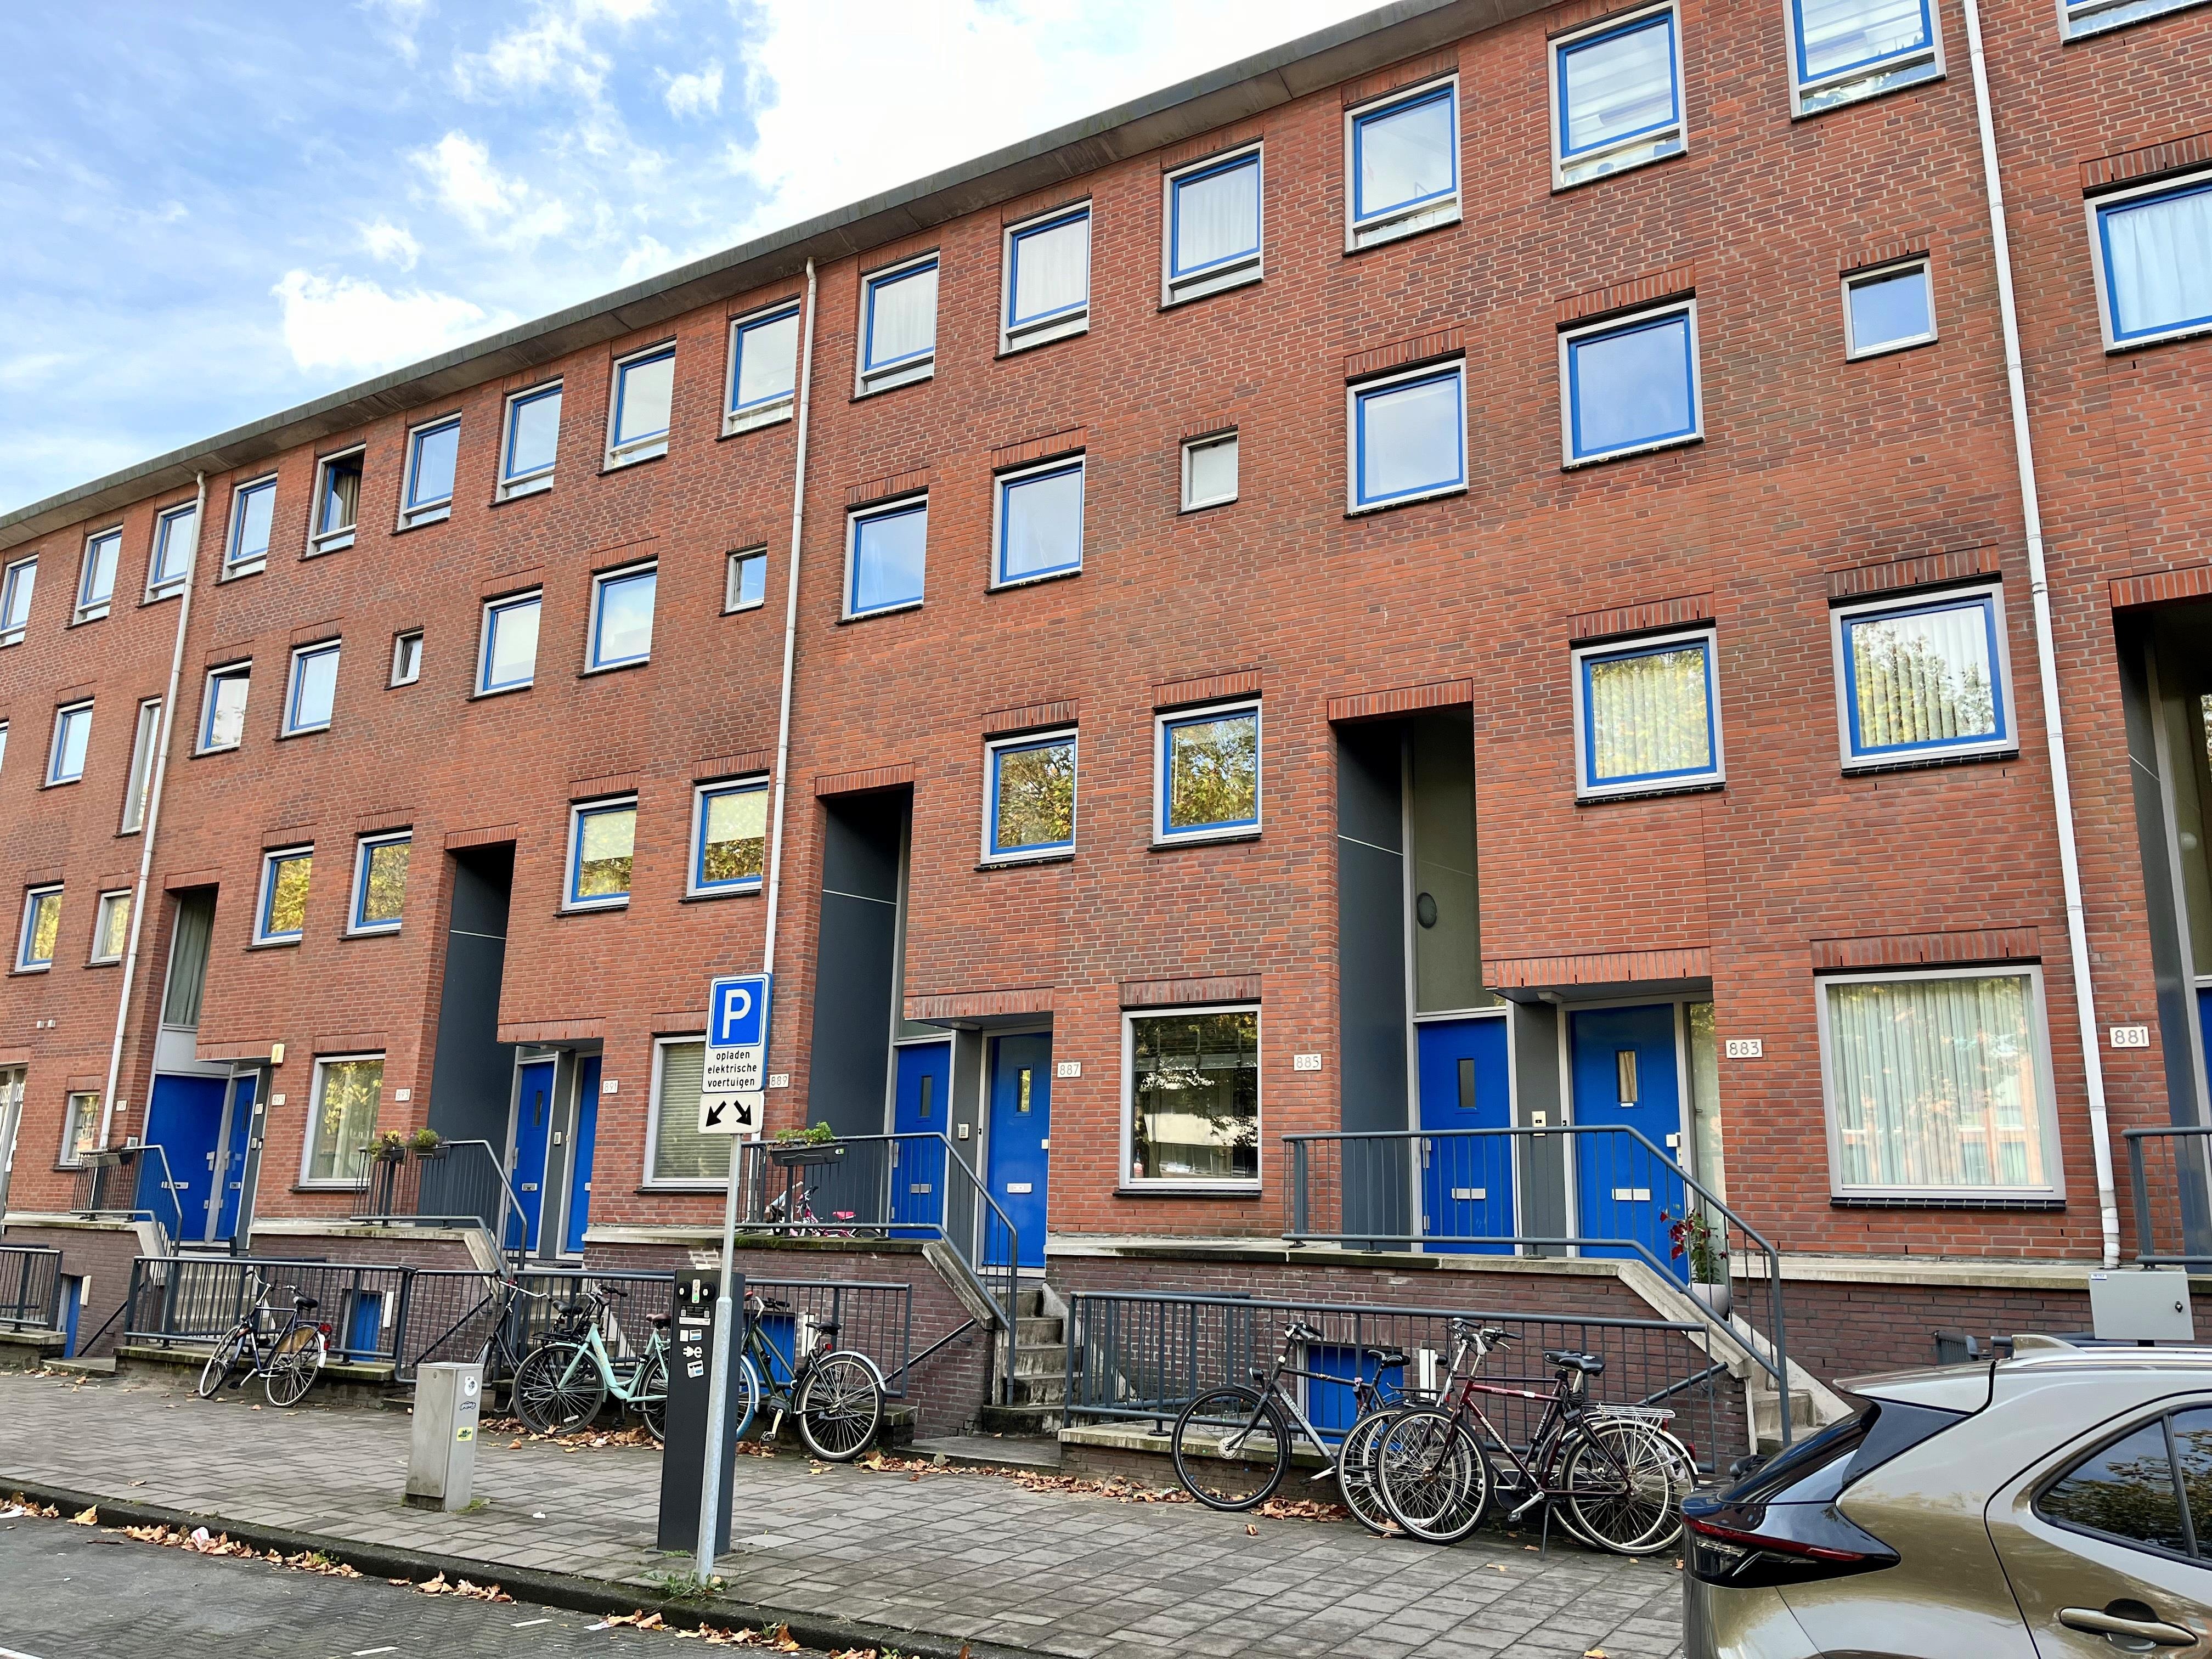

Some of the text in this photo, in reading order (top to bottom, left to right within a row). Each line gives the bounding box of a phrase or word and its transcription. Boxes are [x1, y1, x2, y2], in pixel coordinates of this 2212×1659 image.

[722, 989, 751, 1039] P
[2115, 1029, 2146, 1045] 881
[1730, 1041, 1759, 1056] 883
[716, 1050, 750, 1062] opladen
[1296, 1056, 1319, 1068] 885
[708, 1063, 757, 1074] elektrische
[1060, 1064, 1079, 1075] 887
[708, 1077, 755, 1088] voertuigen
[771, 1076, 787, 1086] 889
[605, 1082, 617, 1092] 891
[273, 1095, 284, 1104] 895
[397, 1090, 409, 1099] 893
